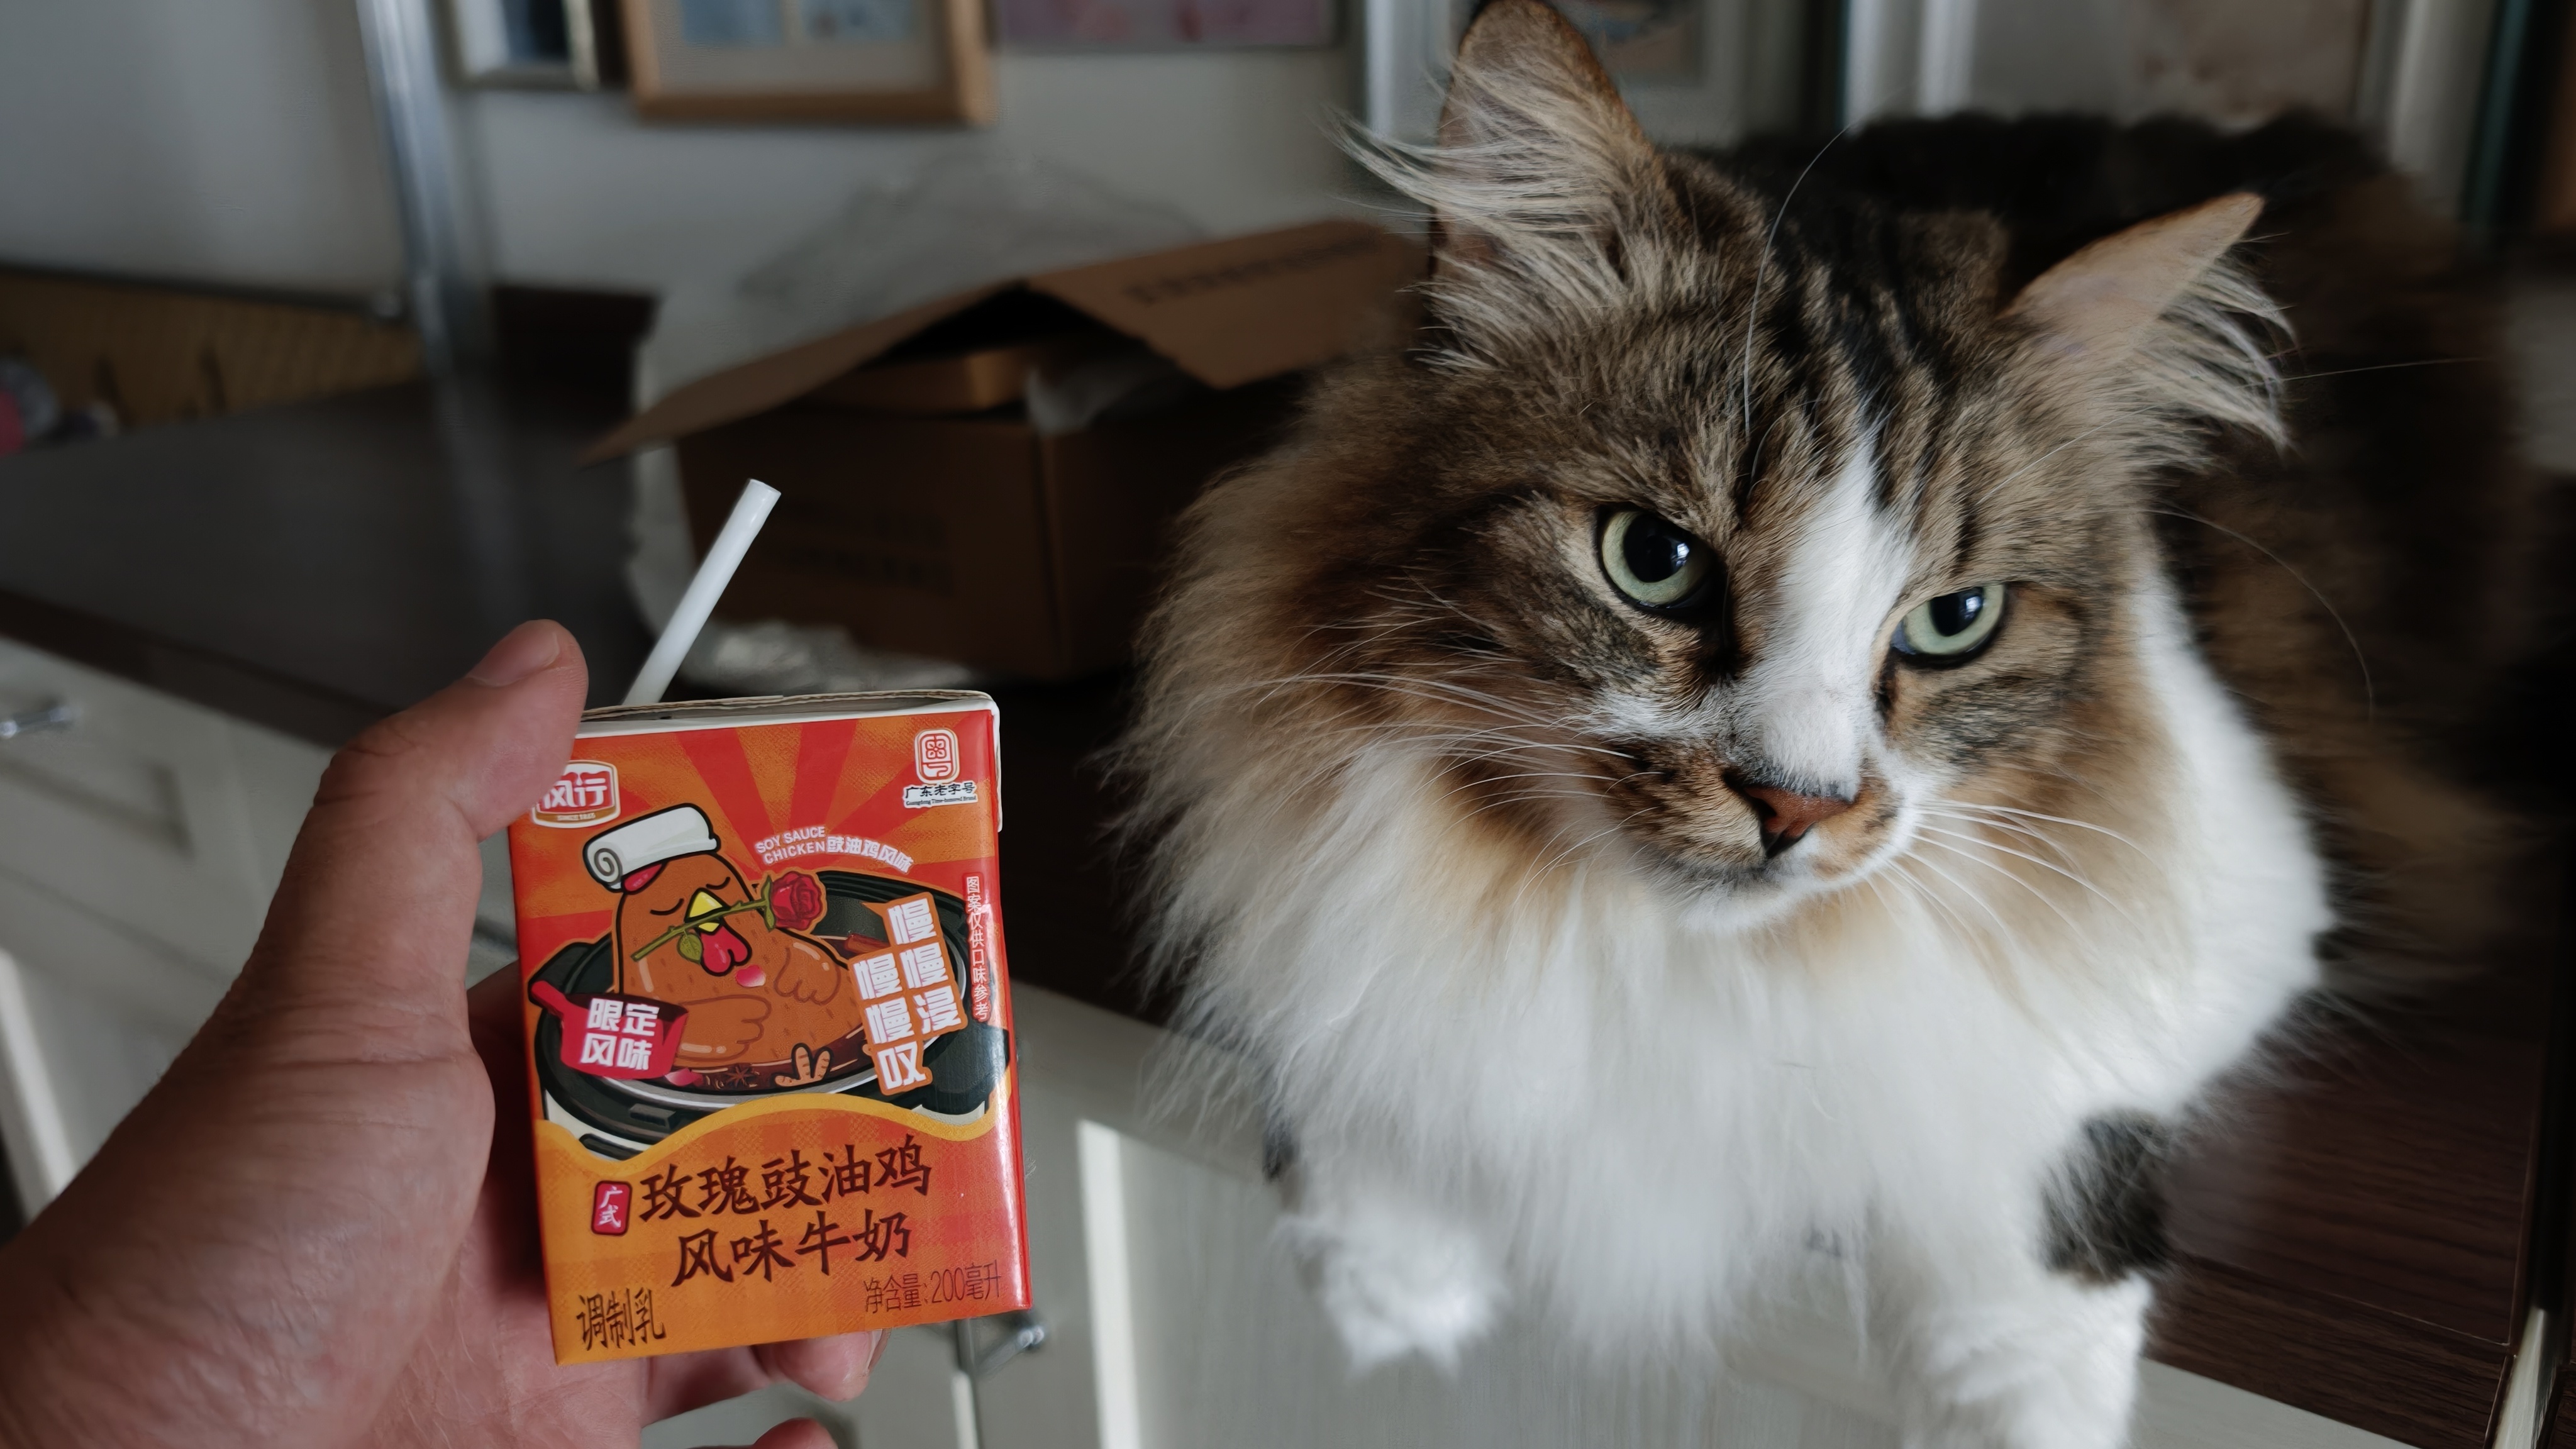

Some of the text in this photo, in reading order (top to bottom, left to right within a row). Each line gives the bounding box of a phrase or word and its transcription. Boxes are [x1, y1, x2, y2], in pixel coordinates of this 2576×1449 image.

[905, 782, 975, 799] 广东老字号
[755, 826, 825, 853] SOY SAUCE
[763, 841, 825, 864] CHICKEN
[826, 836, 914, 873] 豉油鸡风味
[966, 875, 989, 1020] 图案仅供口味参考
[587, 997, 660, 1036] 限定
[580, 1033, 653, 1070] 风味
[639, 1133, 932, 1222] 玫瑰豉油鸡
[598, 1185, 623, 1228] 广式
[671, 1208, 912, 1287] 风味牛奶
[576, 1287, 667, 1352] 调制乳
